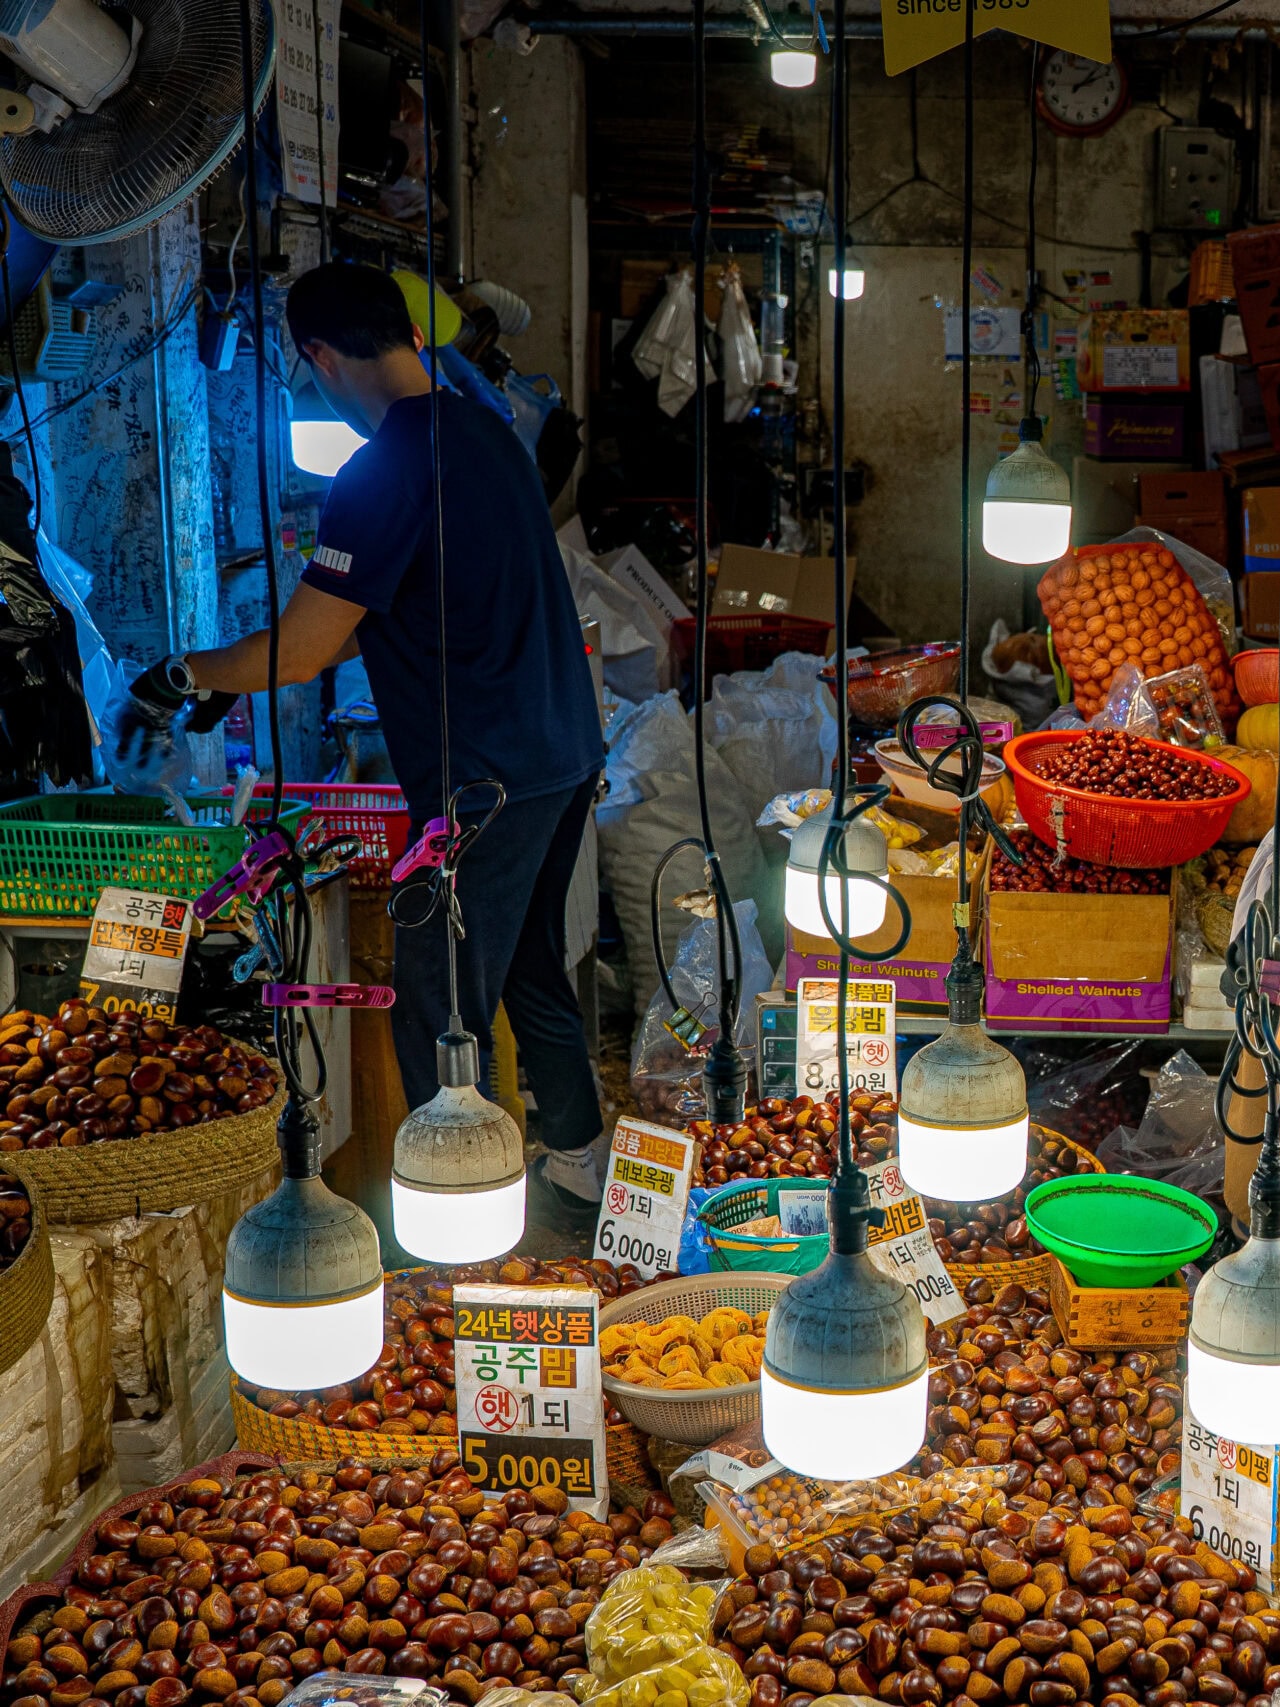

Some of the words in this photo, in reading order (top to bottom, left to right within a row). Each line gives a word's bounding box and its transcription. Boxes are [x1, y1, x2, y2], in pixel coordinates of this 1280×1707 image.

[897, 0, 960, 14] since
[126, 896, 163, 921] 공주
[163, 901, 186, 930] 햇
[878, 963, 939, 979] Walnuts
[1017, 983, 1074, 996] Shelled
[1079, 985, 1142, 998] Walnuts
[864, 1042, 888, 1066] 햇
[615, 1158, 675, 1194] 대보옥광
[609, 1185, 627, 1214] 햇
[630, 1194, 653, 1219] 1되
[599, 1219, 672, 1272] 6,000원
[888, 1241, 916, 1268] 1되
[458, 1309, 593, 1344] 24년햇상품
[471, 1344, 576, 1386] 공주밤
[478, 1388, 515, 1430] 햇
[521, 1393, 570, 1432] 1되
[465, 1438, 592, 1493] 5,000원
[1187, 1422, 1217, 1458] 공주
[1219, 1440, 1237, 1468] 햇
[1238, 1446, 1270, 1484] 이평
[1214, 1473, 1239, 1509] 1되
[1188, 1504, 1262, 1575] 6,000원
